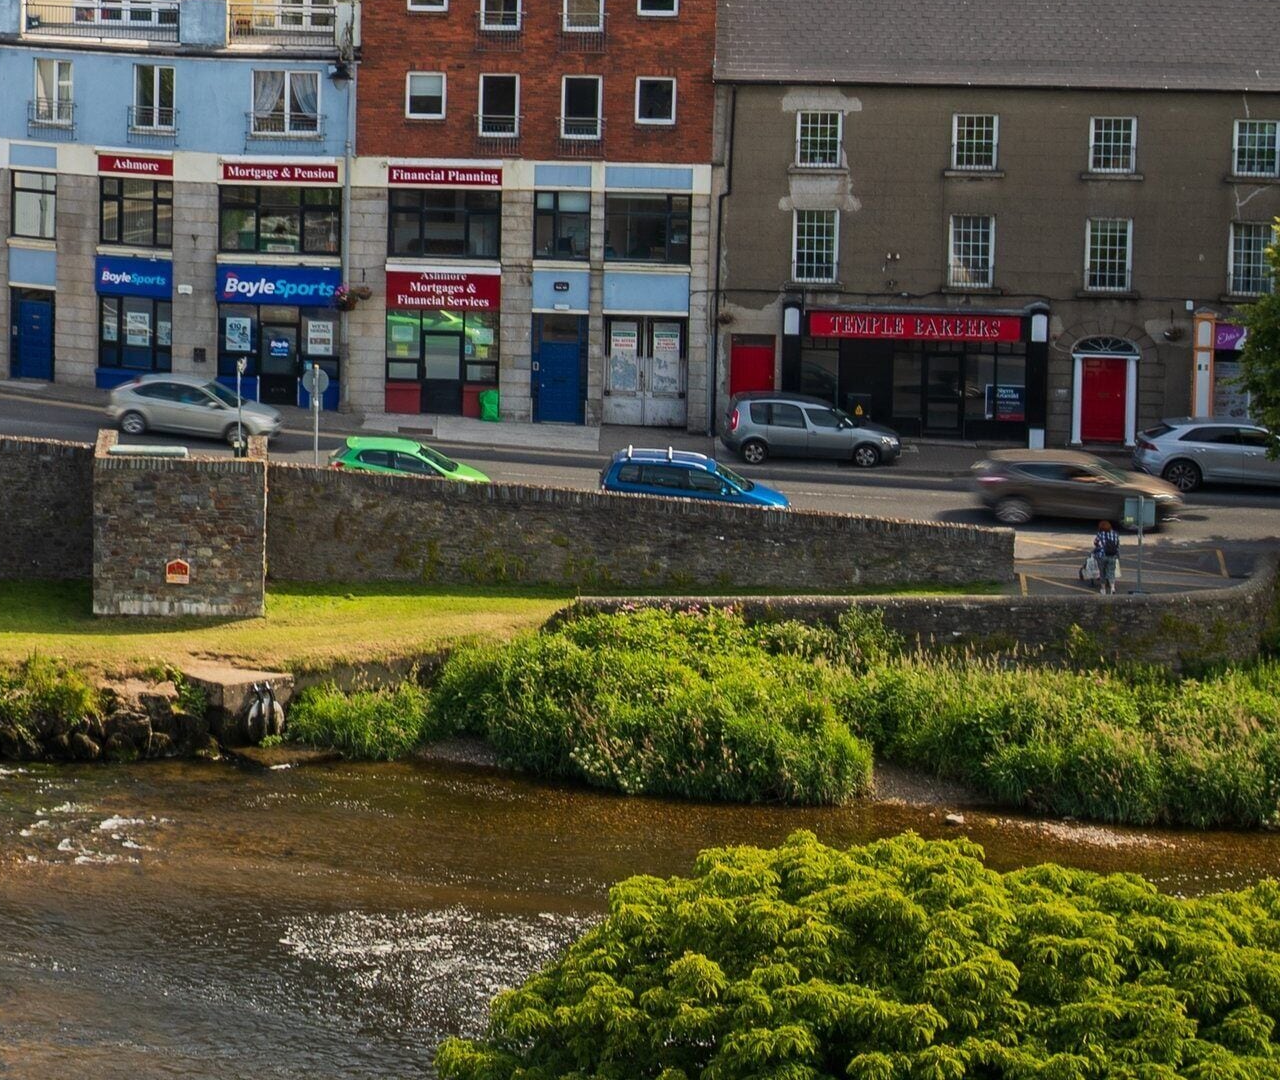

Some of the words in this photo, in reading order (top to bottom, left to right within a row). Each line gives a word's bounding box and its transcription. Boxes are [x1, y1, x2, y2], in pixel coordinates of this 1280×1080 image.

[112, 158, 160, 172] Ashmore
[228, 165, 278, 180] Mortgage
[281, 168, 291, 178] &
[294, 167, 335, 180] Pension
[392, 169, 445, 182] Financial
[448, 170, 499, 184] Planning
[102, 271, 166, 285] BoyleSports
[225, 278, 335, 298] BoyleSports
[409, 282, 464, 296] Mortgages
[467, 283, 476, 293] &
[397, 295, 445, 306] Financial
[447, 295, 489, 307] Services
[830, 316, 905, 335] TEMPLE
[913, 318, 1001, 338] BARBERS
